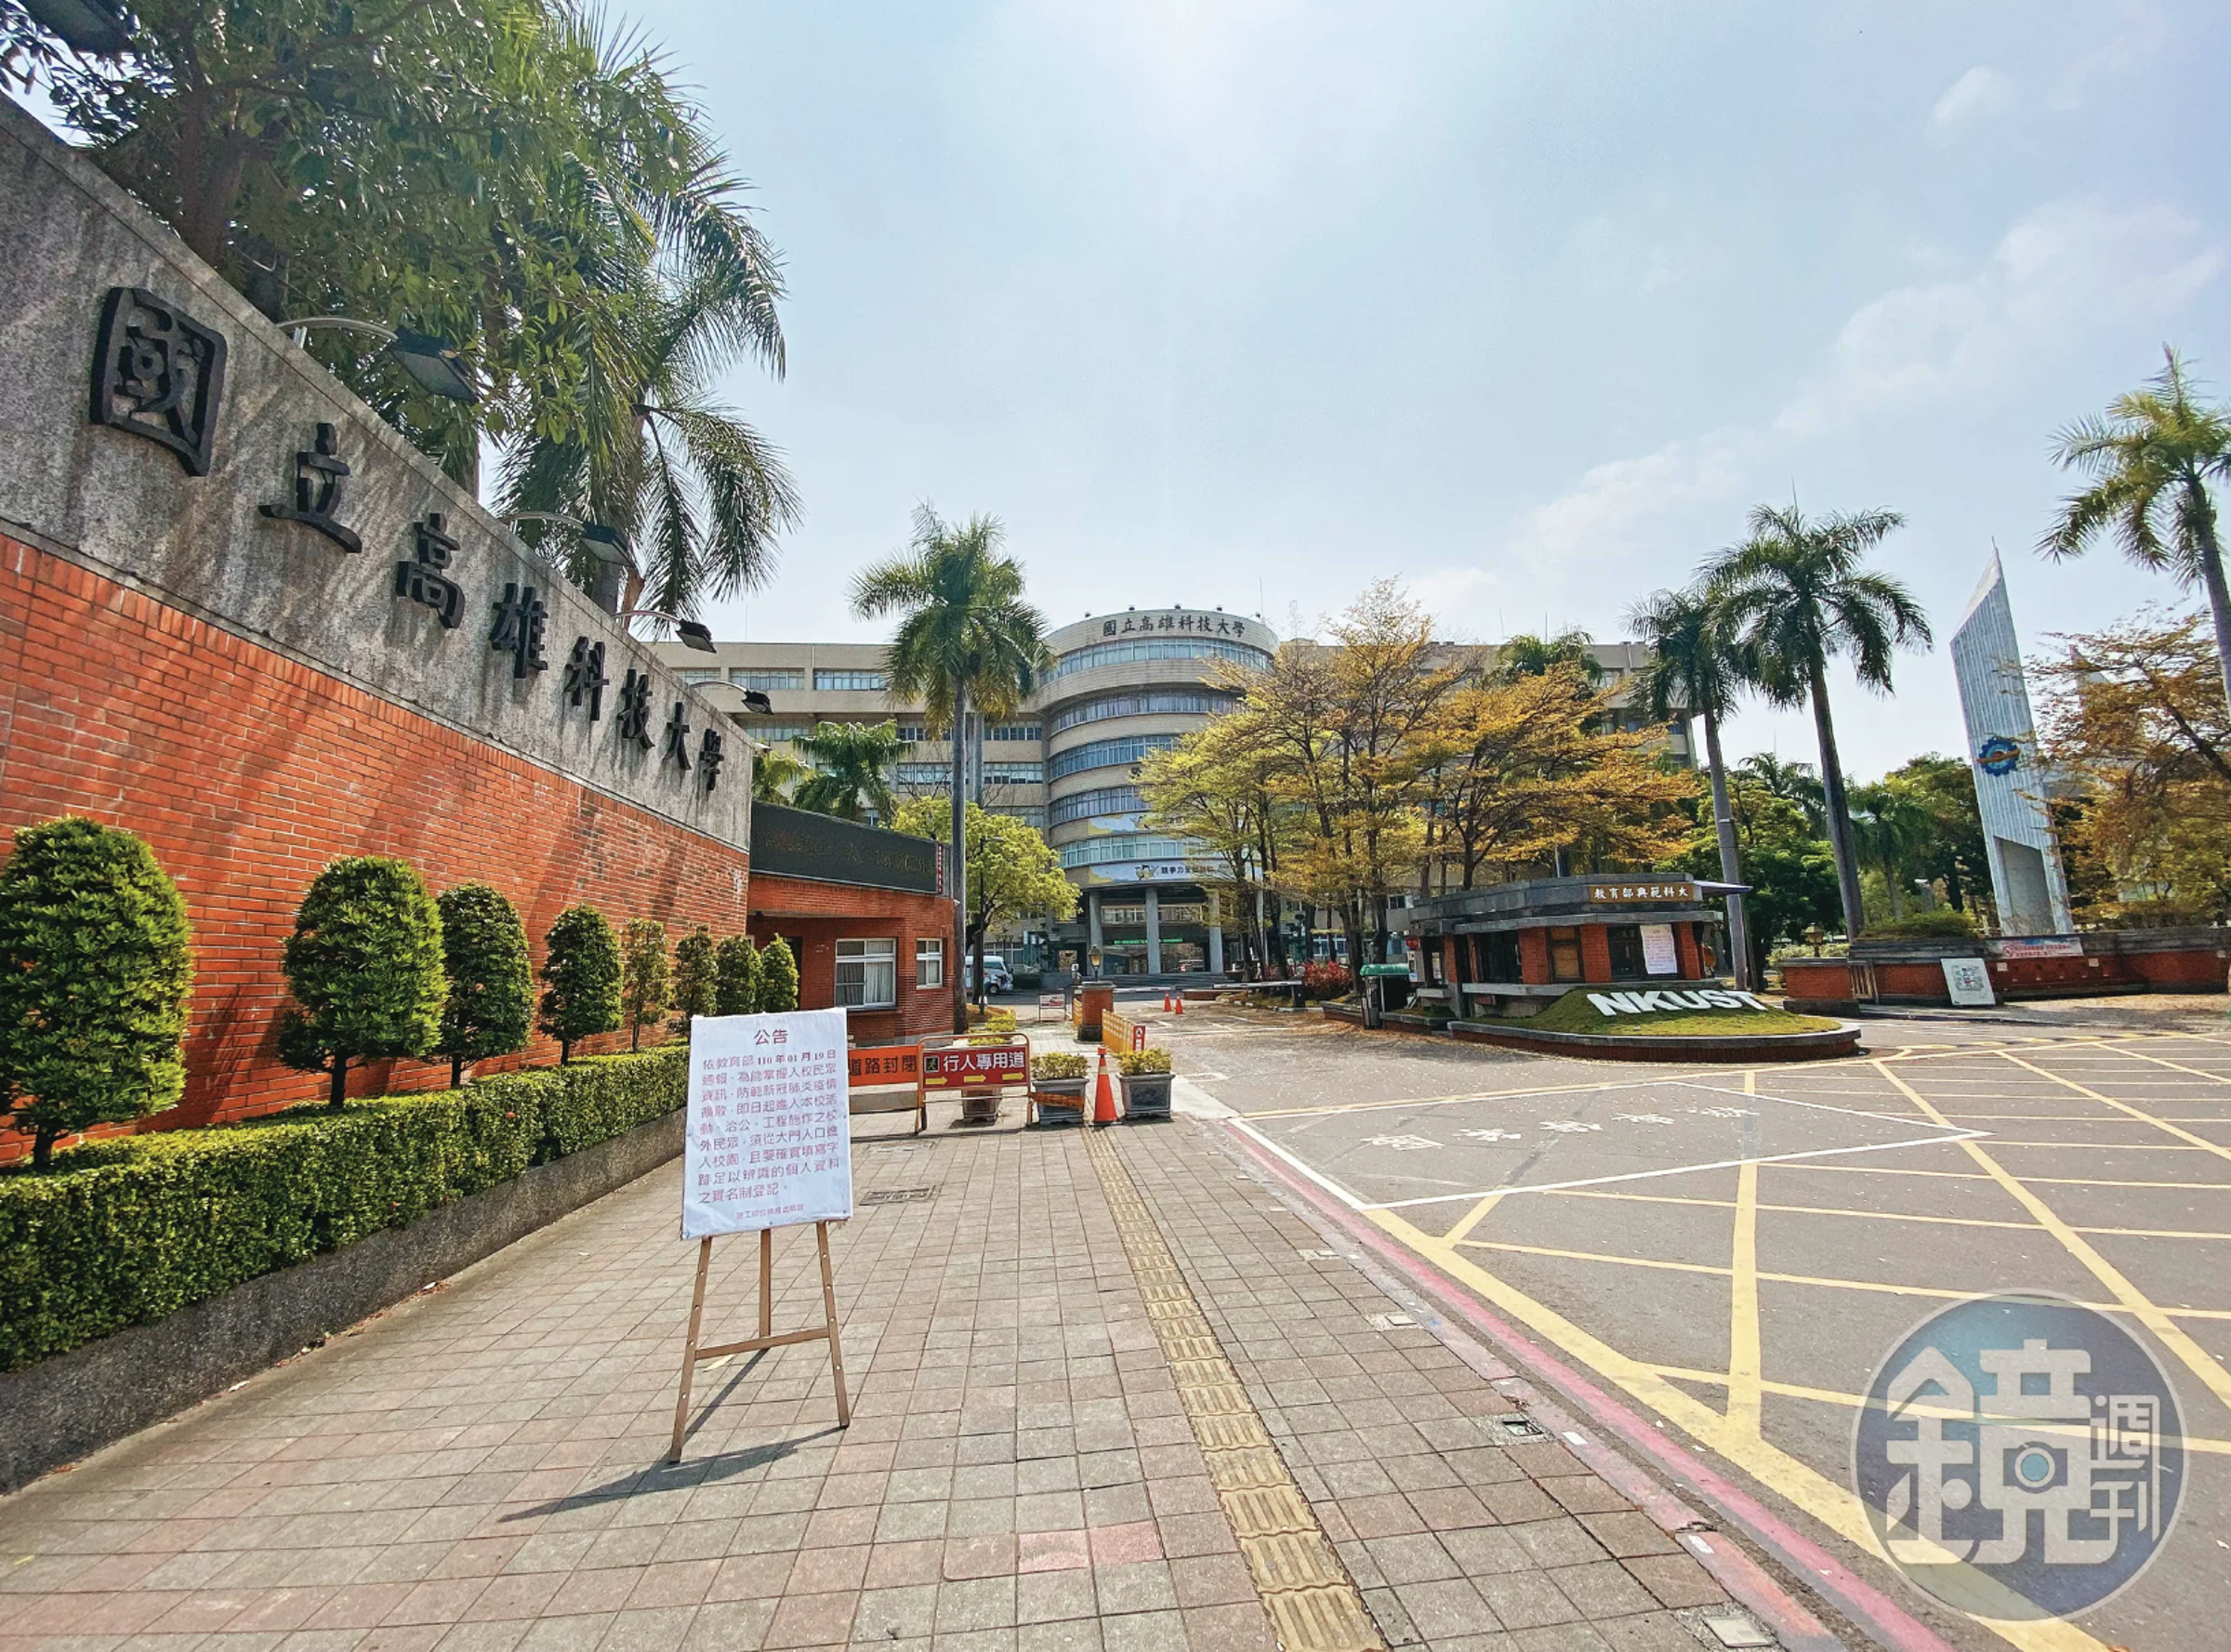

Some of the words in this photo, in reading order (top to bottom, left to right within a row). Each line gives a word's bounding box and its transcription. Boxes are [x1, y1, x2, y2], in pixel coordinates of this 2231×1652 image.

[90, 286, 725, 791] 國立高雄科技大學
[1103, 615, 1245, 638] 國立高雄科技大學
[1587, 990, 1768, 1016] NKUST
[754, 1029, 788, 1045] 公告
[849, 1055, 917, 1077] 道路封閉
[944, 1052, 1024, 1072] 行人專用道
